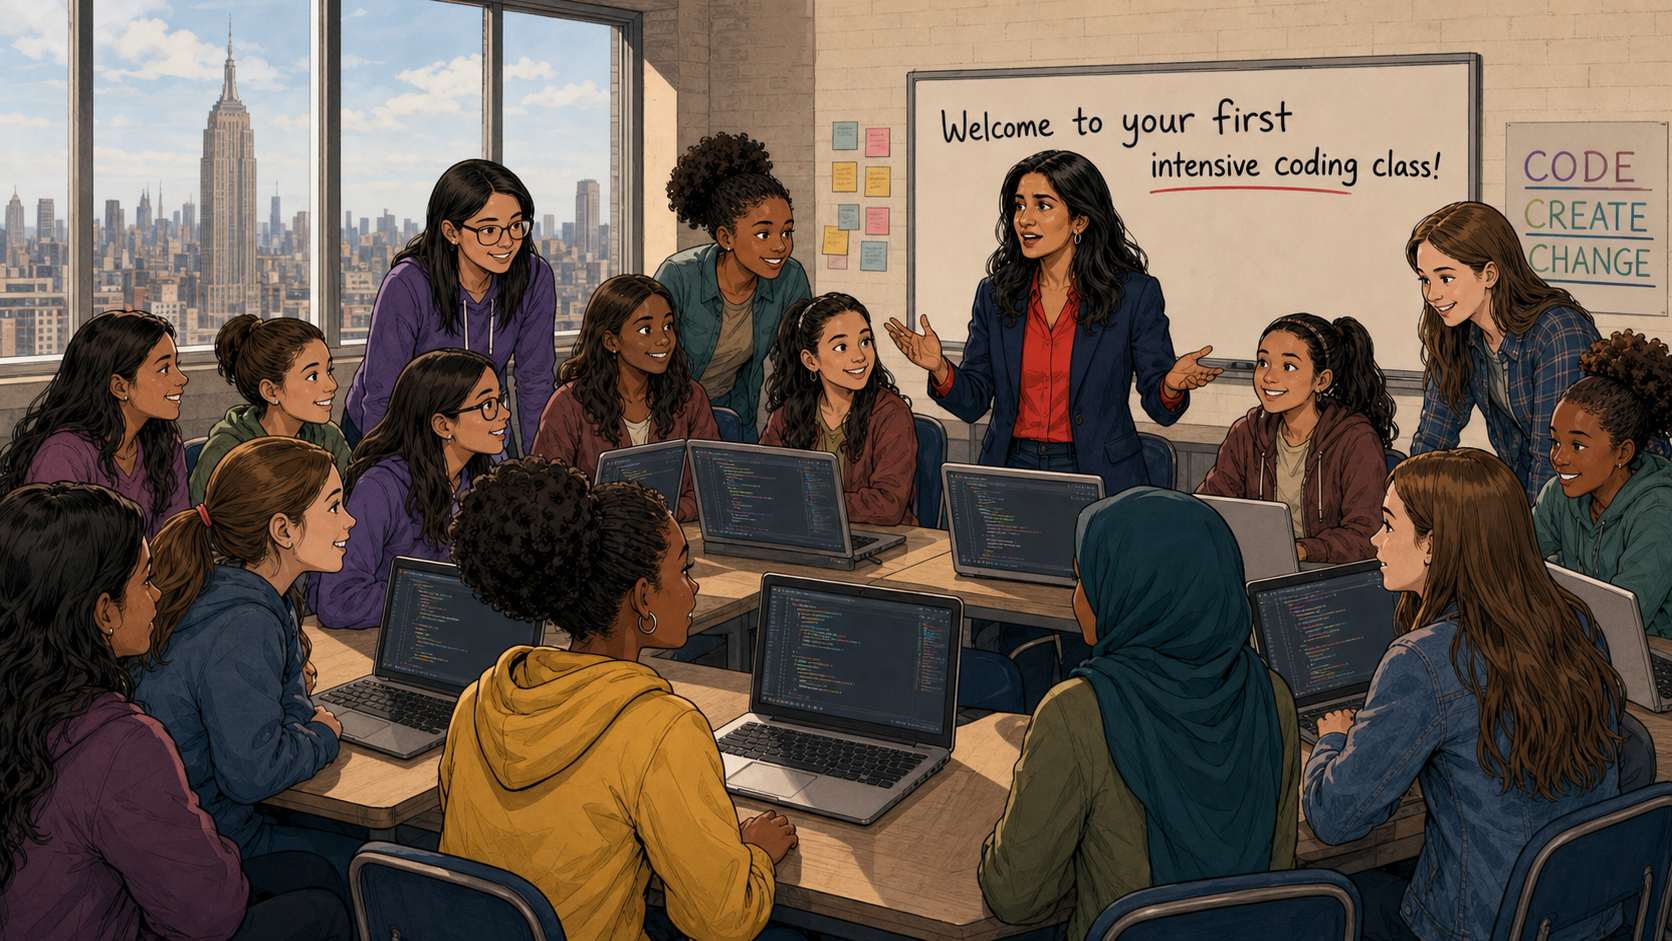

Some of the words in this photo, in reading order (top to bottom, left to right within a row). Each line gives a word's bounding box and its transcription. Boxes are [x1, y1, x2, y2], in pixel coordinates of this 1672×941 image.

[941, 110, 1054, 143] Welcome
[1072, 106, 1103, 135] to
[1122, 113, 1195, 148] your
[1213, 98, 1292, 135] first
[1151, 152, 1260, 178] intensive
[1275, 146, 1358, 186] coding
[1373, 149, 1441, 179] class!
[1524, 150, 1635, 182] CODE
[1524, 199, 1648, 232] CREATE
[1529, 244, 1651, 277] CHANGE
